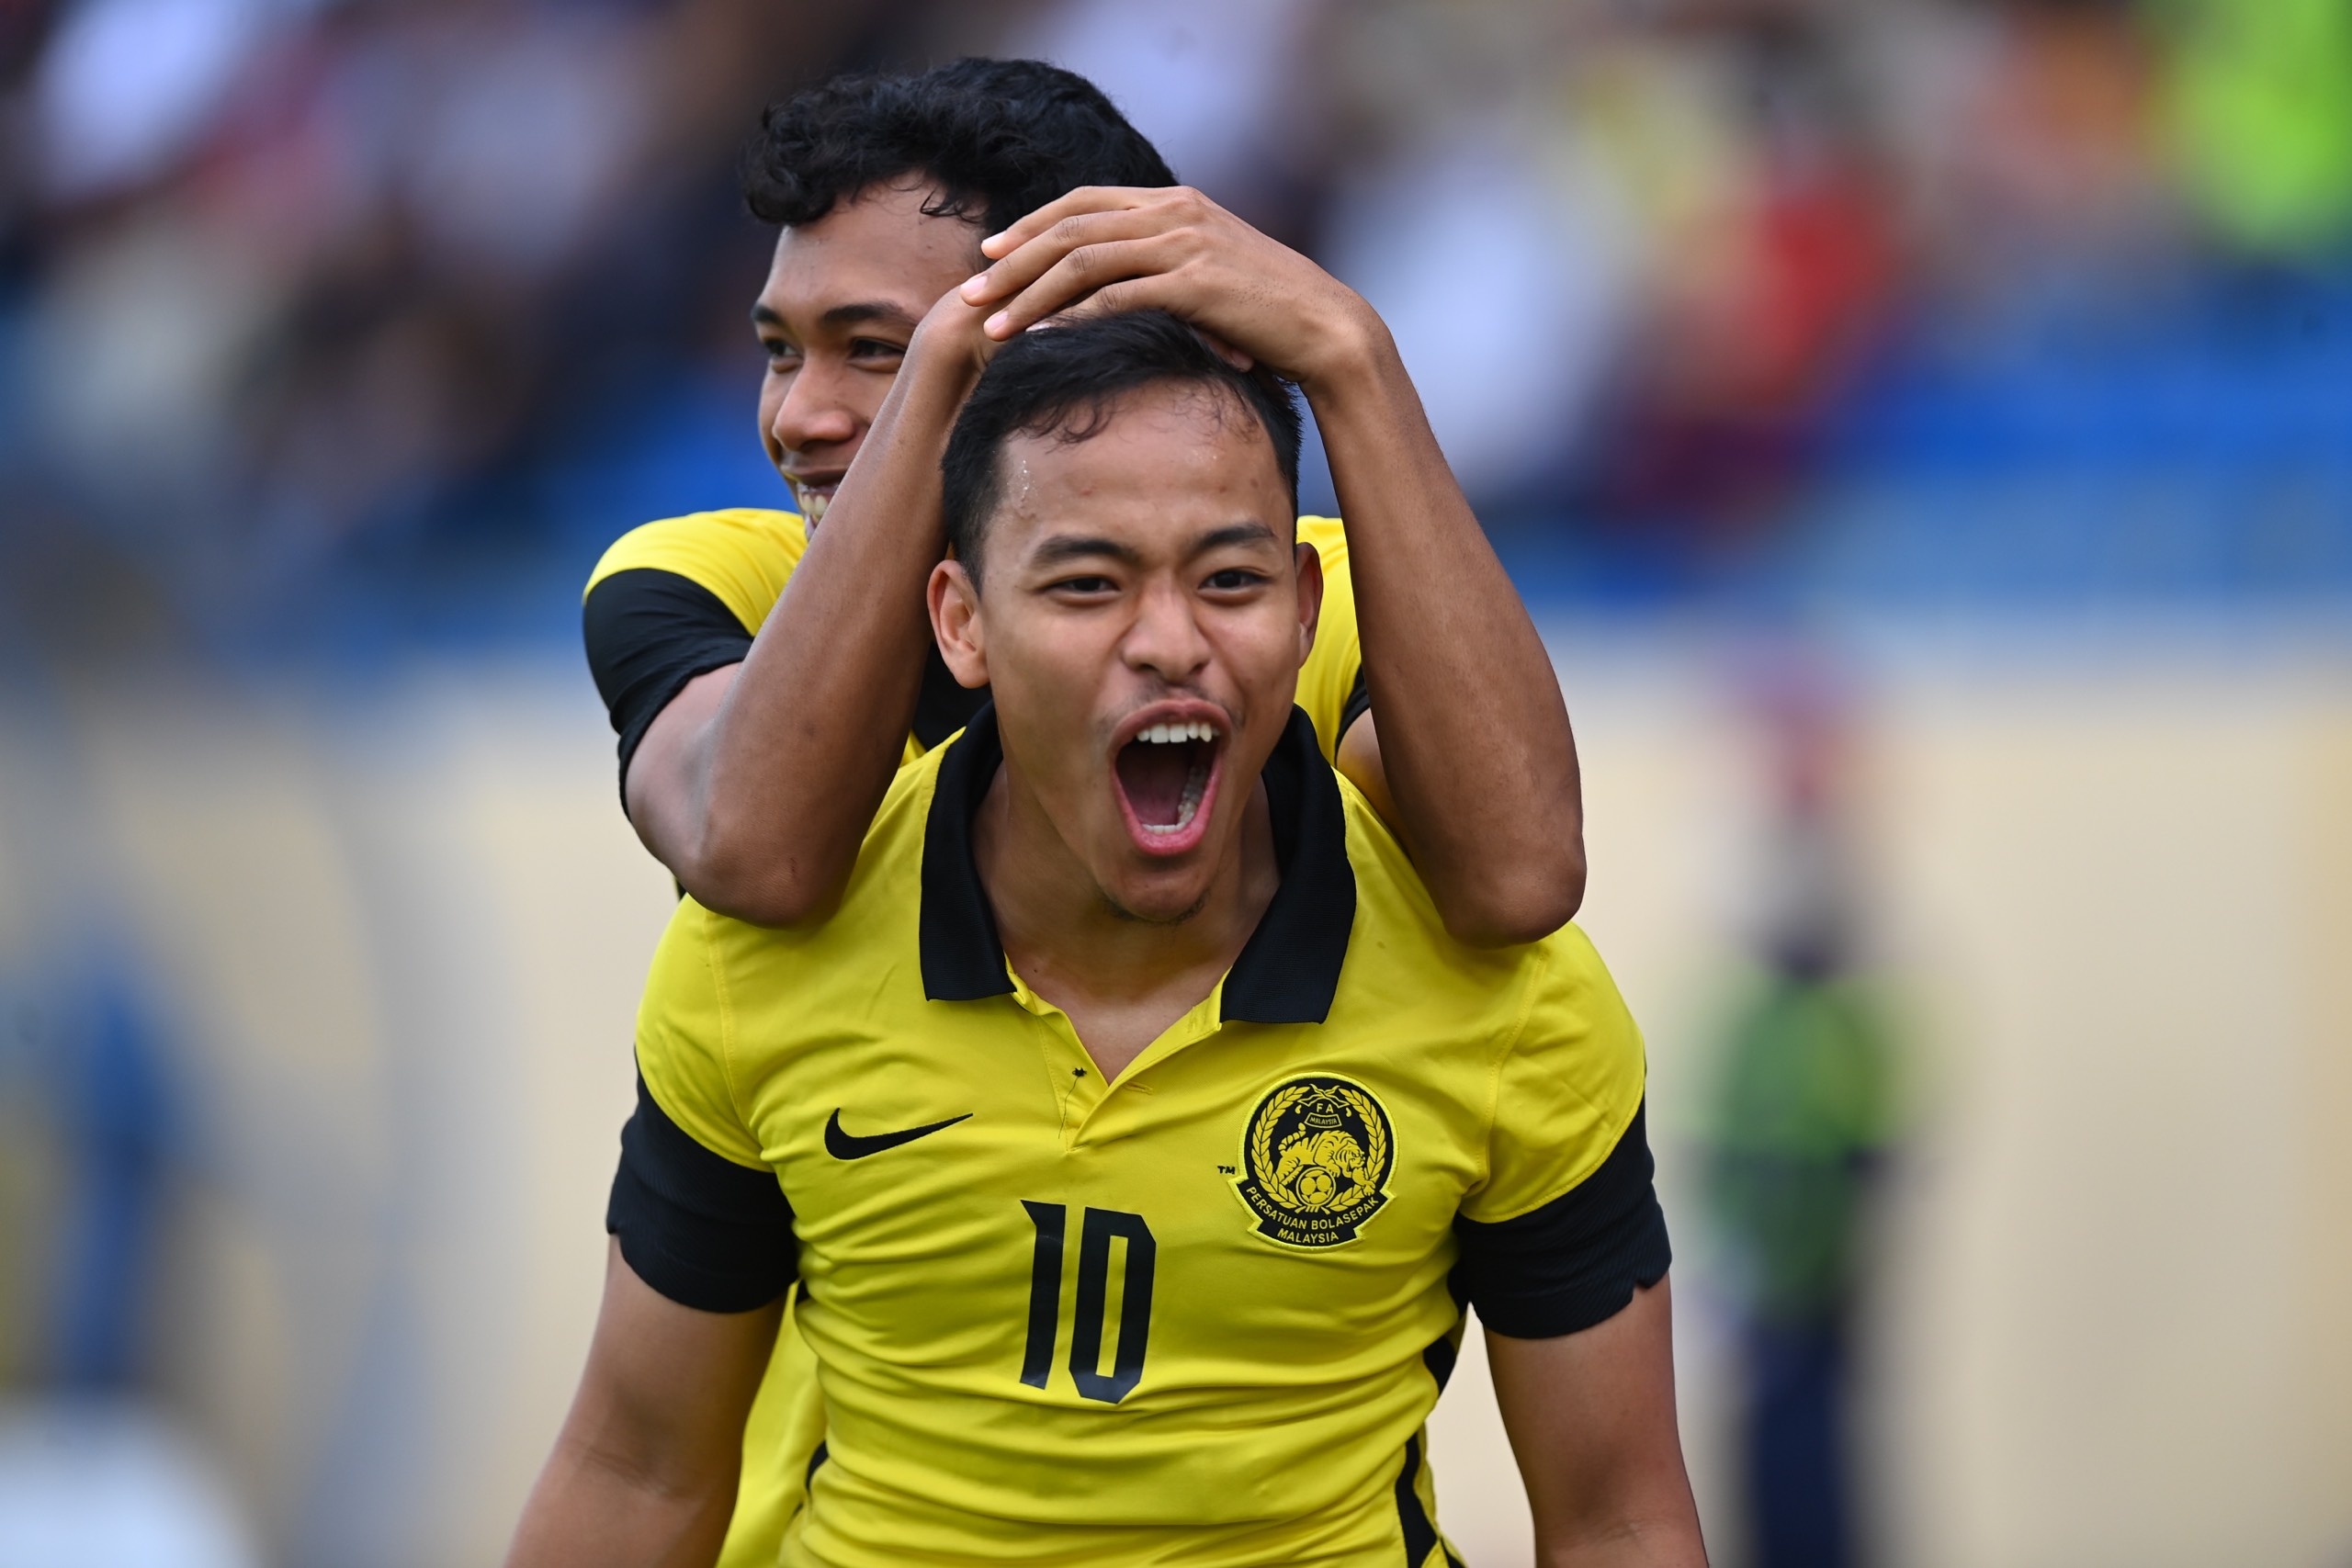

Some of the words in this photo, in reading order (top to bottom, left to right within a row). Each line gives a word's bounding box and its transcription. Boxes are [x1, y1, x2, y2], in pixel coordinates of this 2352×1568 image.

[1308, 1117, 1338, 1125] MALAYSIA
[1246, 1186, 1307, 1230] PERSATUAN
[1311, 1197, 1379, 1230] BOLASEPAK
[1277, 1227, 1340, 1244] MALAYSIA
[1019, 1199, 1157, 1404] 10
